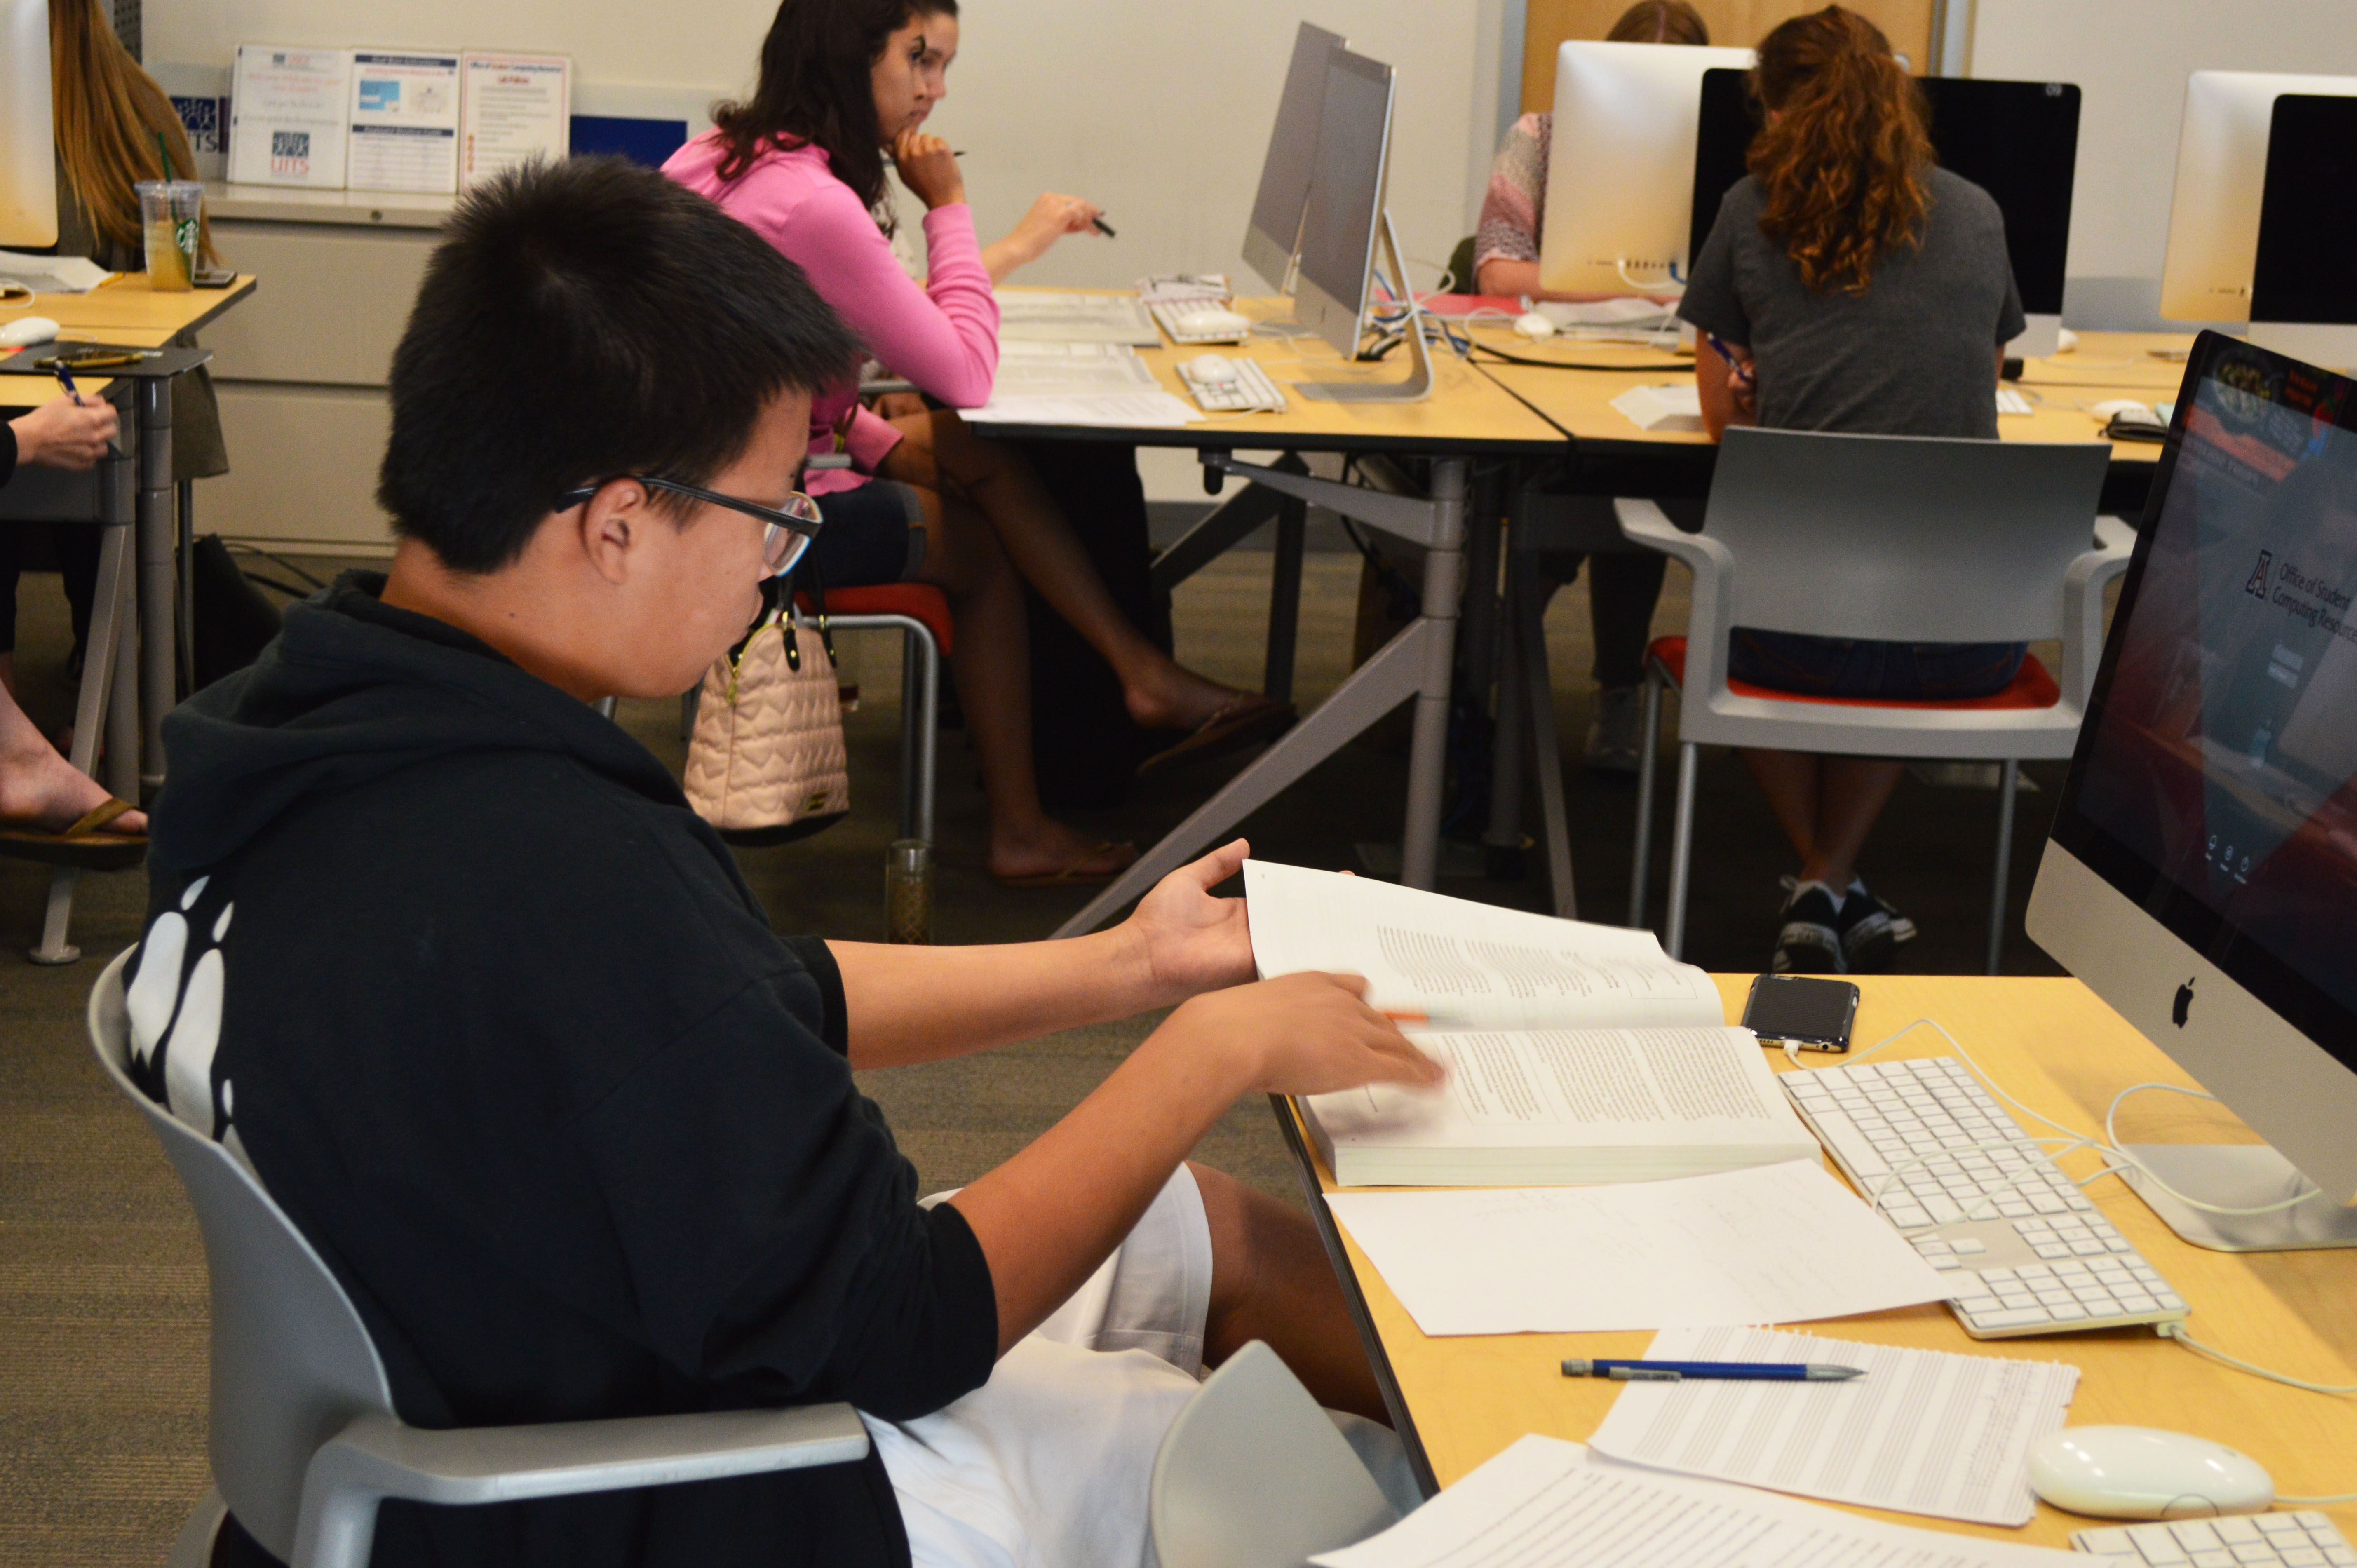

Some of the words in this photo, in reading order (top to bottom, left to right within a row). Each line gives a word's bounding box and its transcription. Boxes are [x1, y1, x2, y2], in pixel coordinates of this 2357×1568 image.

[188, 131, 218, 153] TS
[271, 157, 309, 174] UITS
[2245, 549, 2272, 599] A
[2280, 563, 2305, 589] Office
[2305, 578, 2318, 593] of
[2315, 580, 2350, 611] Student
[2272, 586, 2319, 628] Computing
